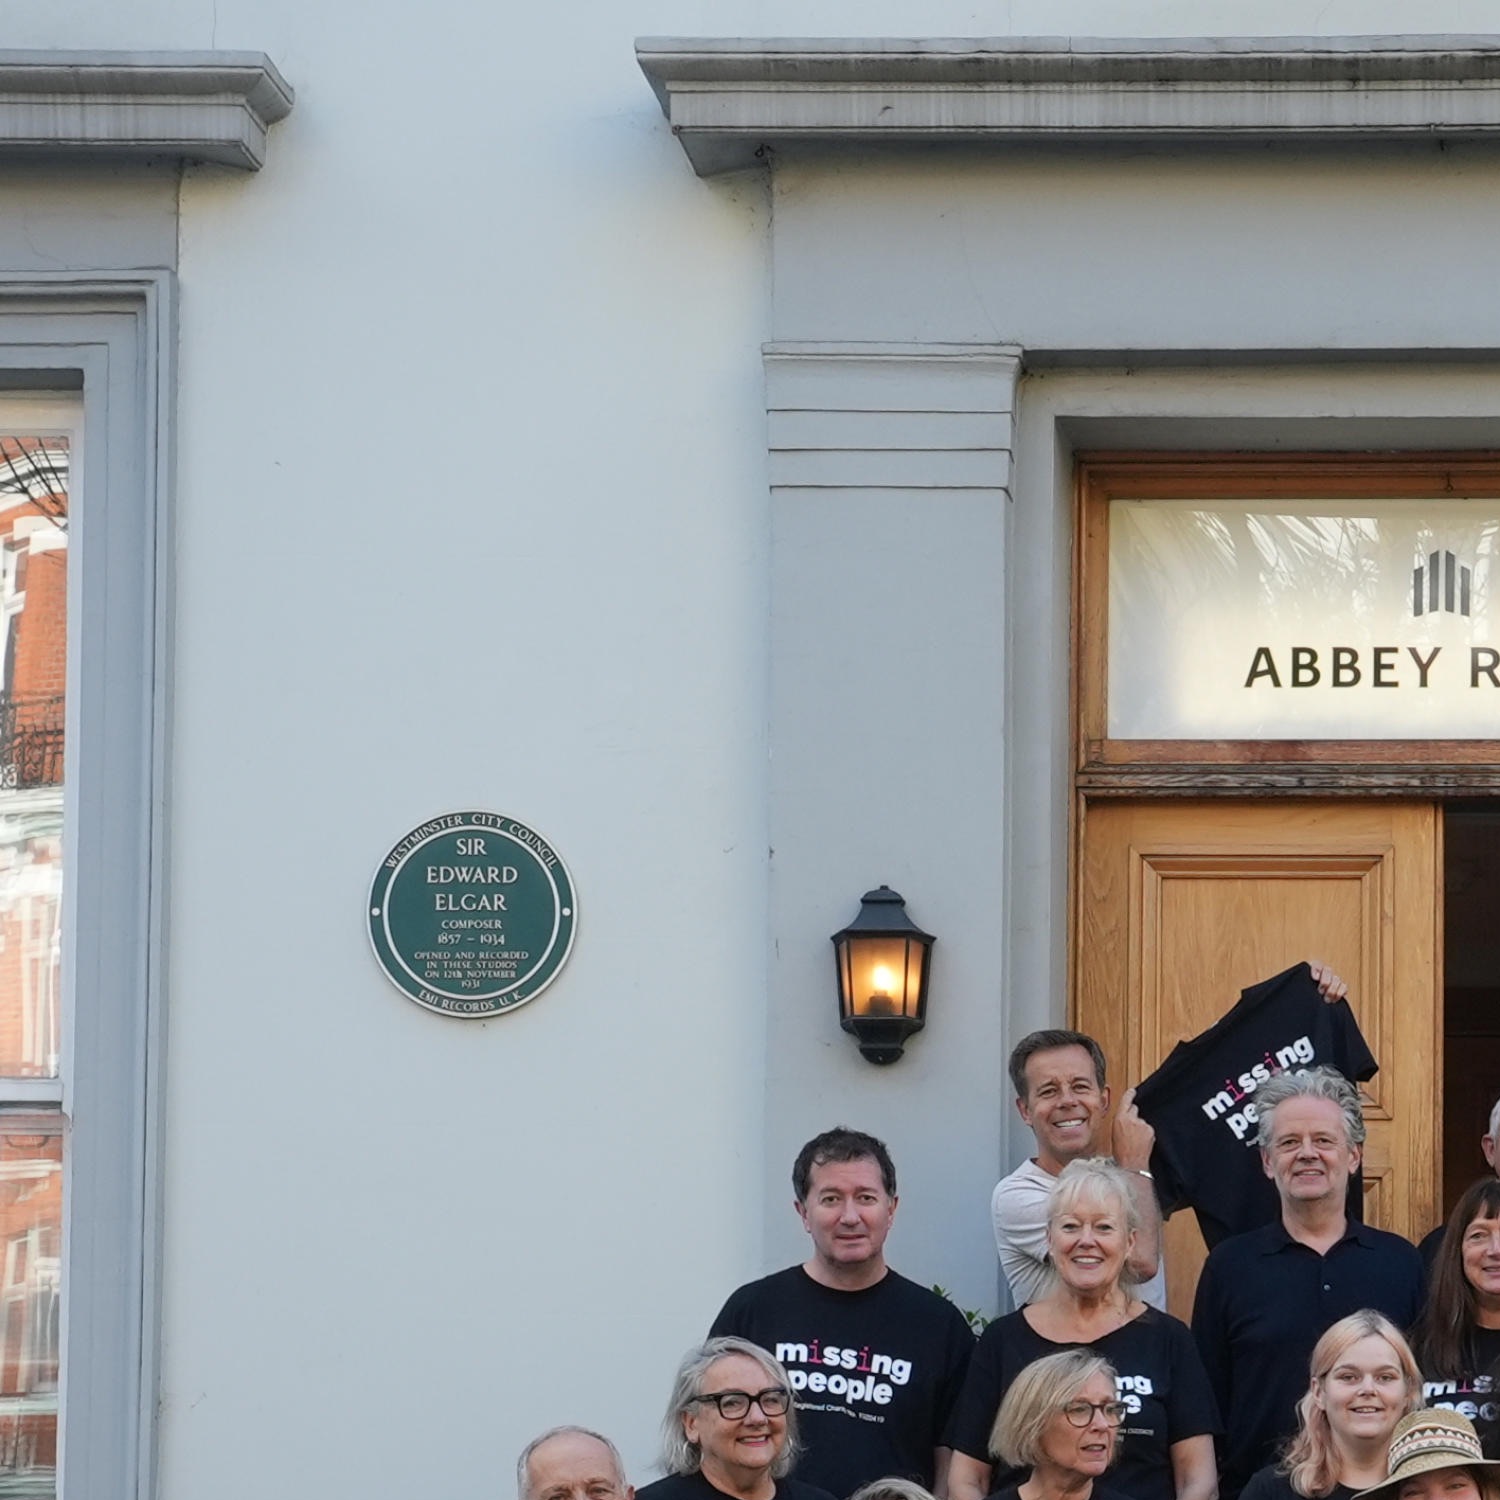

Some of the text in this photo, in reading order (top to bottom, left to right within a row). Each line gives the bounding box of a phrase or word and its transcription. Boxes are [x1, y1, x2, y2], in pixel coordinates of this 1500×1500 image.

[1244, 646, 1443, 688] ABBEY
[385, 813, 559, 870] WESTMINSTER CITY COUNCIL
[456, 838, 488, 856] SIR
[426, 865, 519, 884] EDWARD
[434, 893, 508, 911] ELGAR
[441, 919, 503, 930] COMPOSER
[437, 934, 461, 945] 1857
[480, 934, 505, 946] 1934
[414, 951, 529, 960] OPENED AND RECORDED
[426, 960, 518, 969] IN THESE STUDIOS
[424, 970, 439, 978] ON
[466, 970, 516, 978] NOVEMBER
[461, 980, 481, 989] 1931
[418, 989, 438, 1005] EMI
[441, 999, 495, 1012] RECORDS
[1201, 1035, 1316, 1121] missing
[775, 1339, 913, 1385] missing
